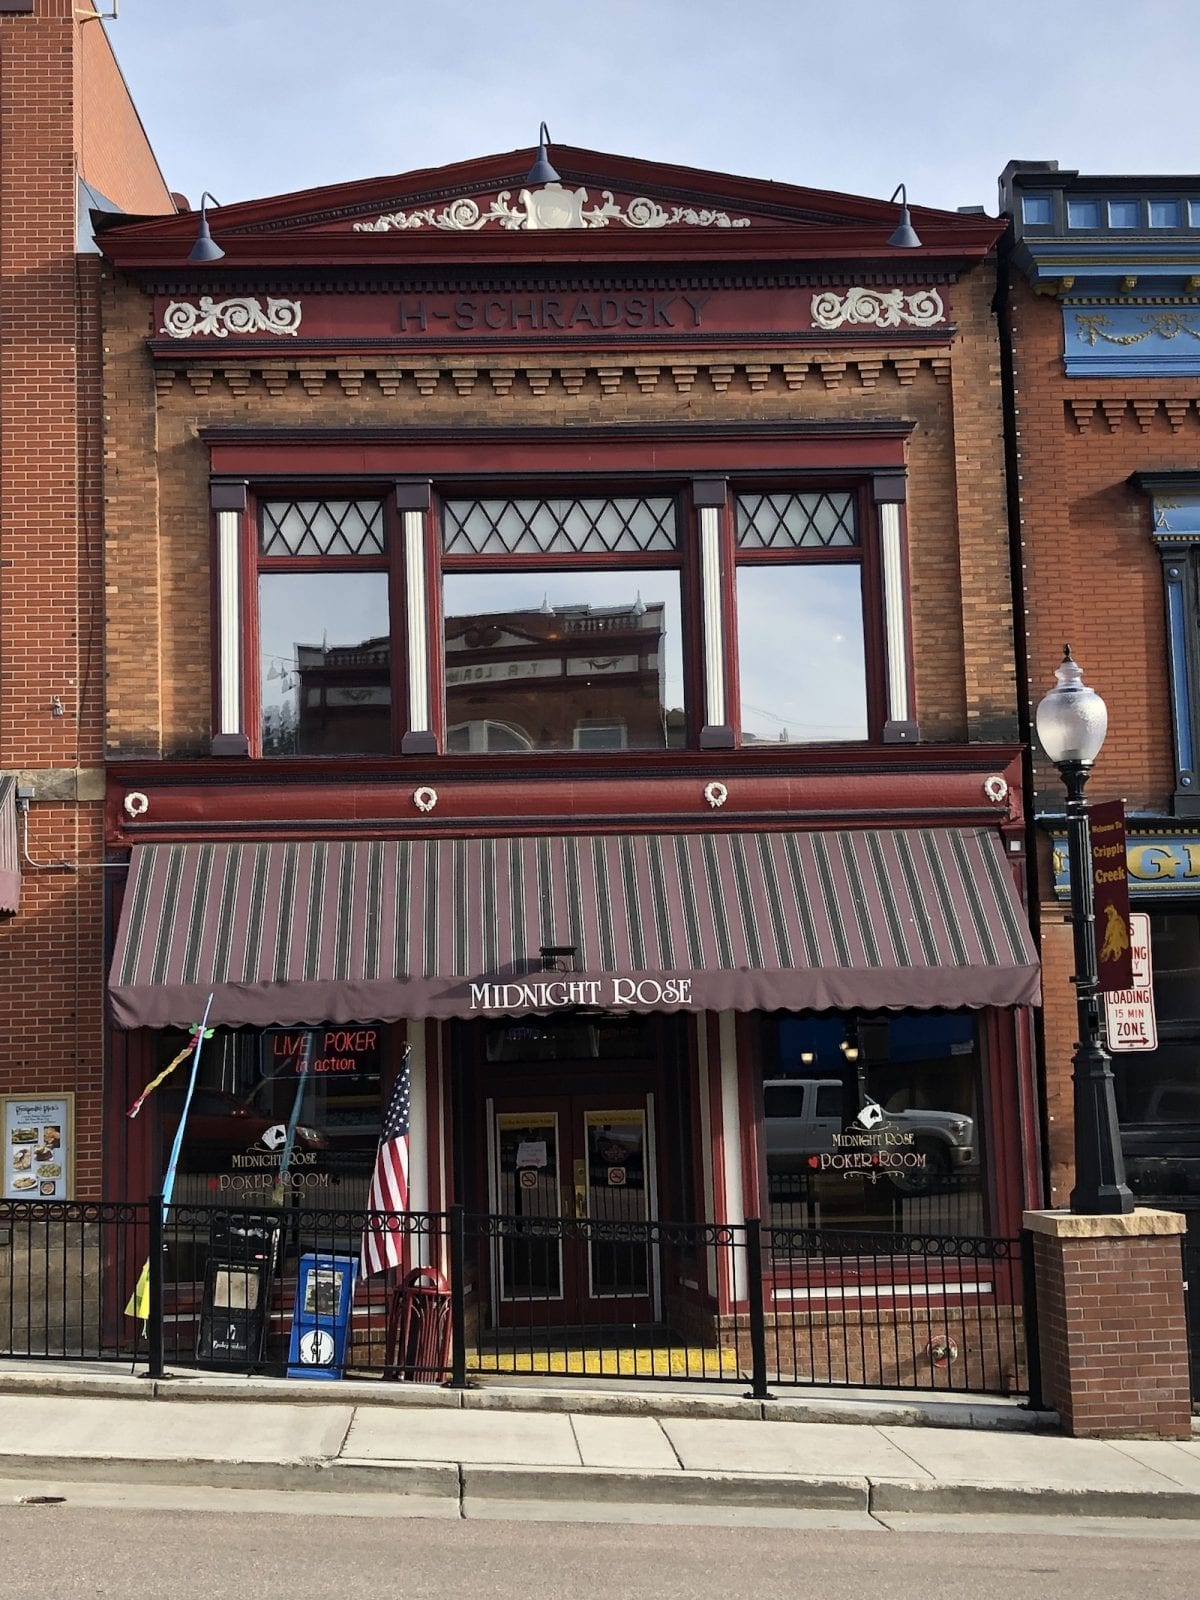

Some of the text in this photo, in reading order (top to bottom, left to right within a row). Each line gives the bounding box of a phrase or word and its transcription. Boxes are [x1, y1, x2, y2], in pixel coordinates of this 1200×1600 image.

[400, 297, 710, 331] H-SCHRADSKY
[1093, 843, 1124, 858] Cripple
[1095, 866, 1126, 883] Creek
[469, 978, 692, 1009] MIDNIGHT ROSE
[1108, 990, 1149, 1005] LOADING
[1115, 1009, 1144, 1019] 15 MIN
[1117, 1022, 1146, 1036] ZONE
[274, 1031, 376, 1056] LIVE POKER
[296, 1057, 356, 1073] in action
[832, 1132, 915, 1147] MIDNIGHT ROSE
[232, 1152, 317, 1168] MIDNIGHT ROSE
[820, 1150, 926, 1170] POKER ROOM
[220, 1170, 328, 1191] POKER ROOM
